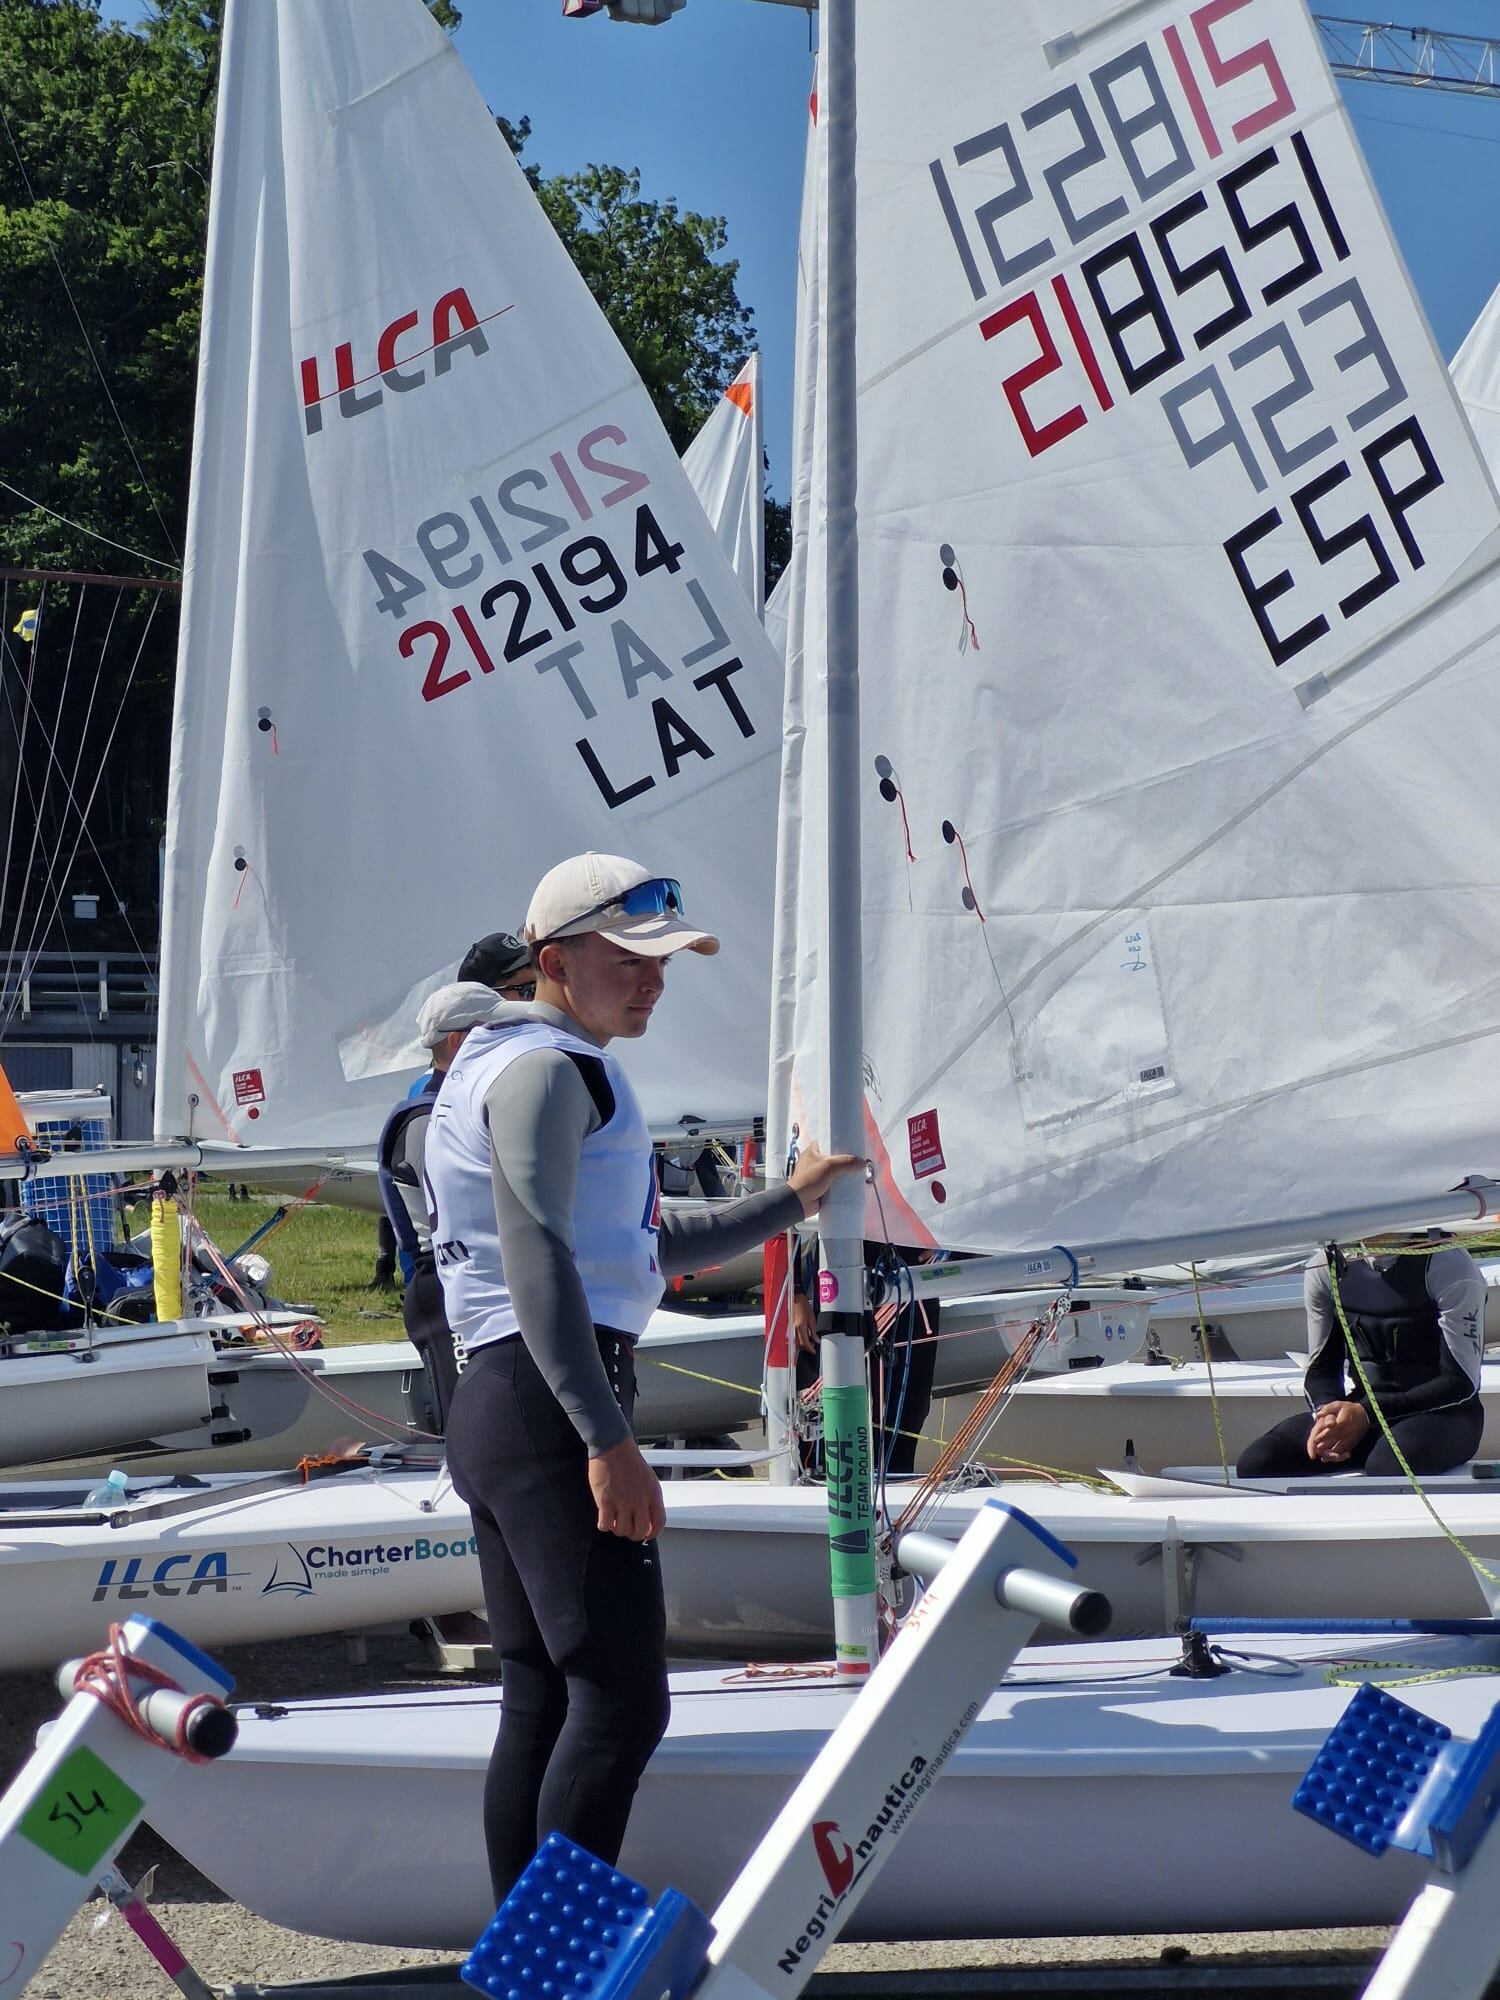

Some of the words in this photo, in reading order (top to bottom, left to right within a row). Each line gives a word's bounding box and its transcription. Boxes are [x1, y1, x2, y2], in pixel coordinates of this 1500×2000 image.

[301, 286, 490, 436] ILCA
[978, 130, 1351, 458] 218551
[398, 503, 685, 702] 212194
[1222, 415, 1444, 667] ESP
[575, 656, 757, 809] LAT
[825, 1437, 853, 1520] ILCA
[857, 1483, 869, 1521] TEAM
[858, 1426, 868, 1476] POLAND
[91, 1551, 228, 1602] ILCA
[314, 1568, 348, 1580] made
[350, 1566, 390, 1581] simple
[889, 1701, 979, 1835] www.negrinautica.com
[777, 1894, 836, 1975] Negri
[855, 1754, 928, 1859] nautica
